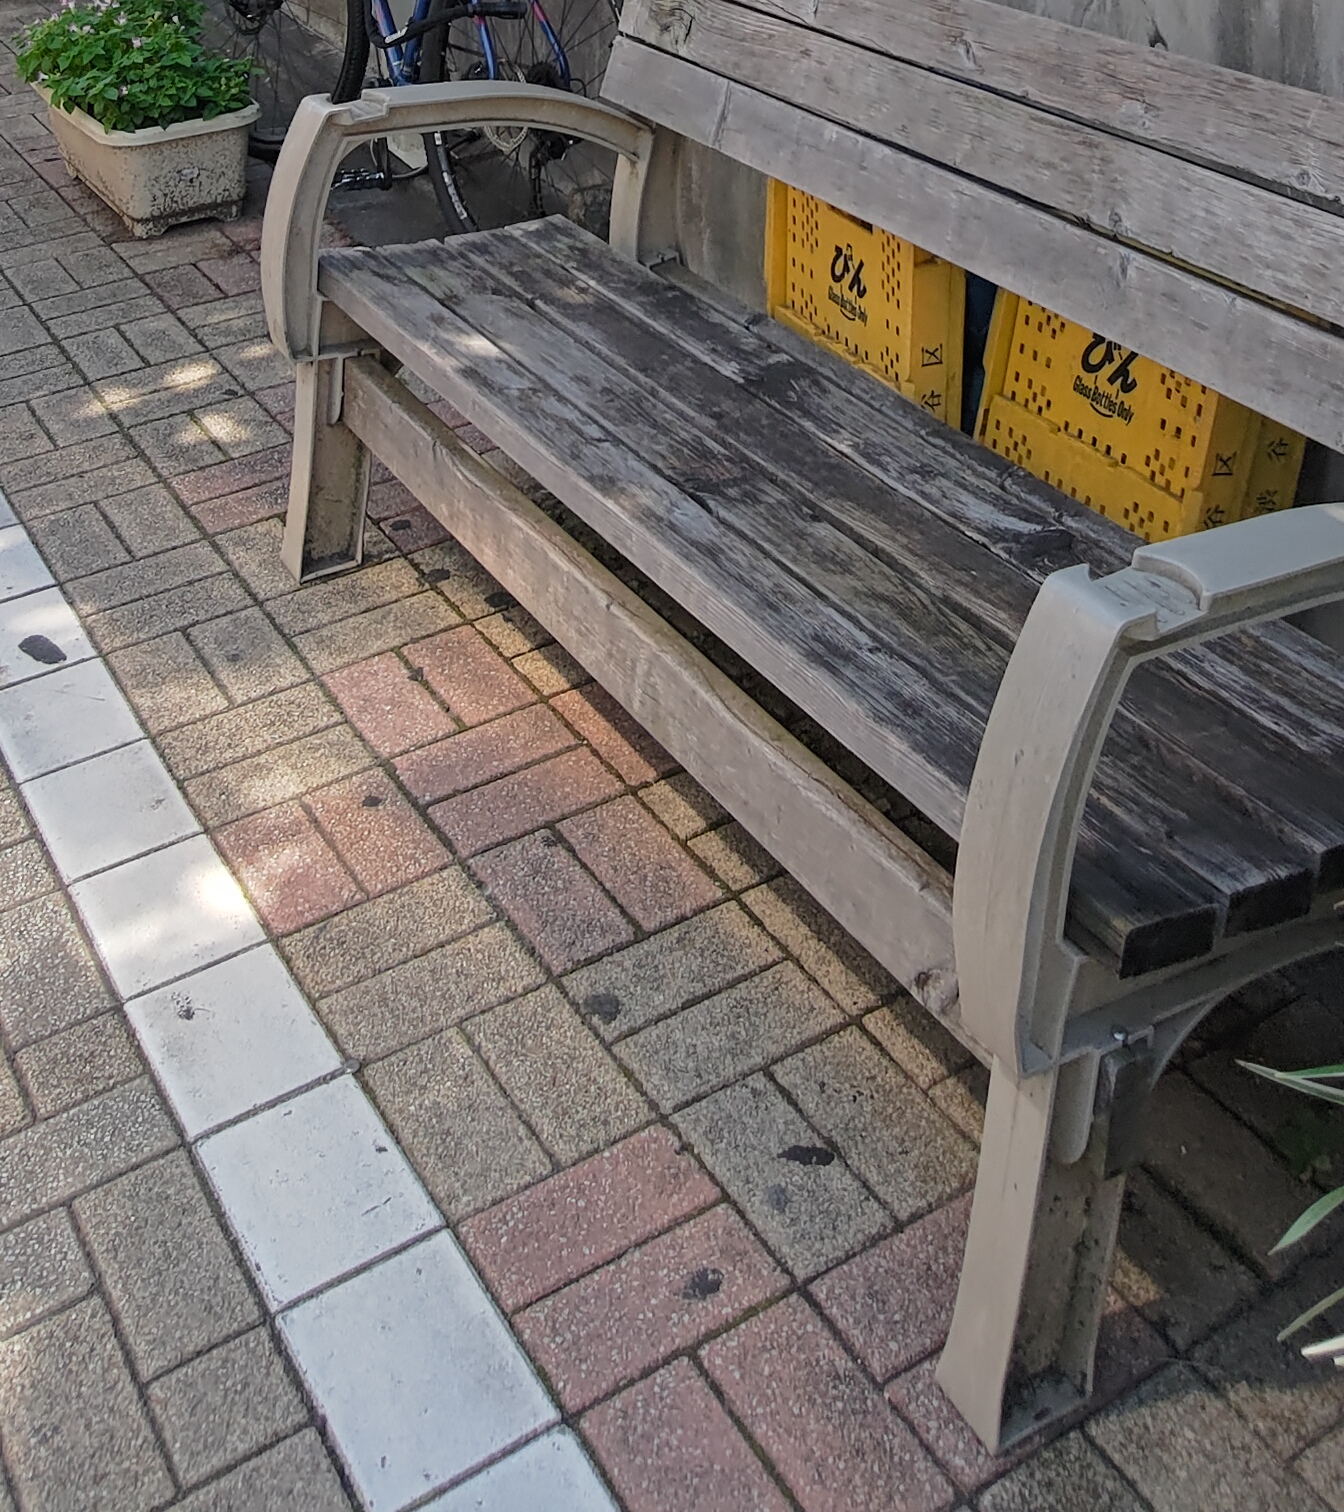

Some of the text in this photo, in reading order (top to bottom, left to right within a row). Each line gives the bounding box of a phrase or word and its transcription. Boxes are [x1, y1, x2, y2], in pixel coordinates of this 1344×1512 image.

[830, 243, 867, 299] びん
[827, 285, 868, 327] Glass Bottles Only
[1081, 332, 1139, 394] びん
[1073, 375, 1135, 425] Glass Bottles Only
